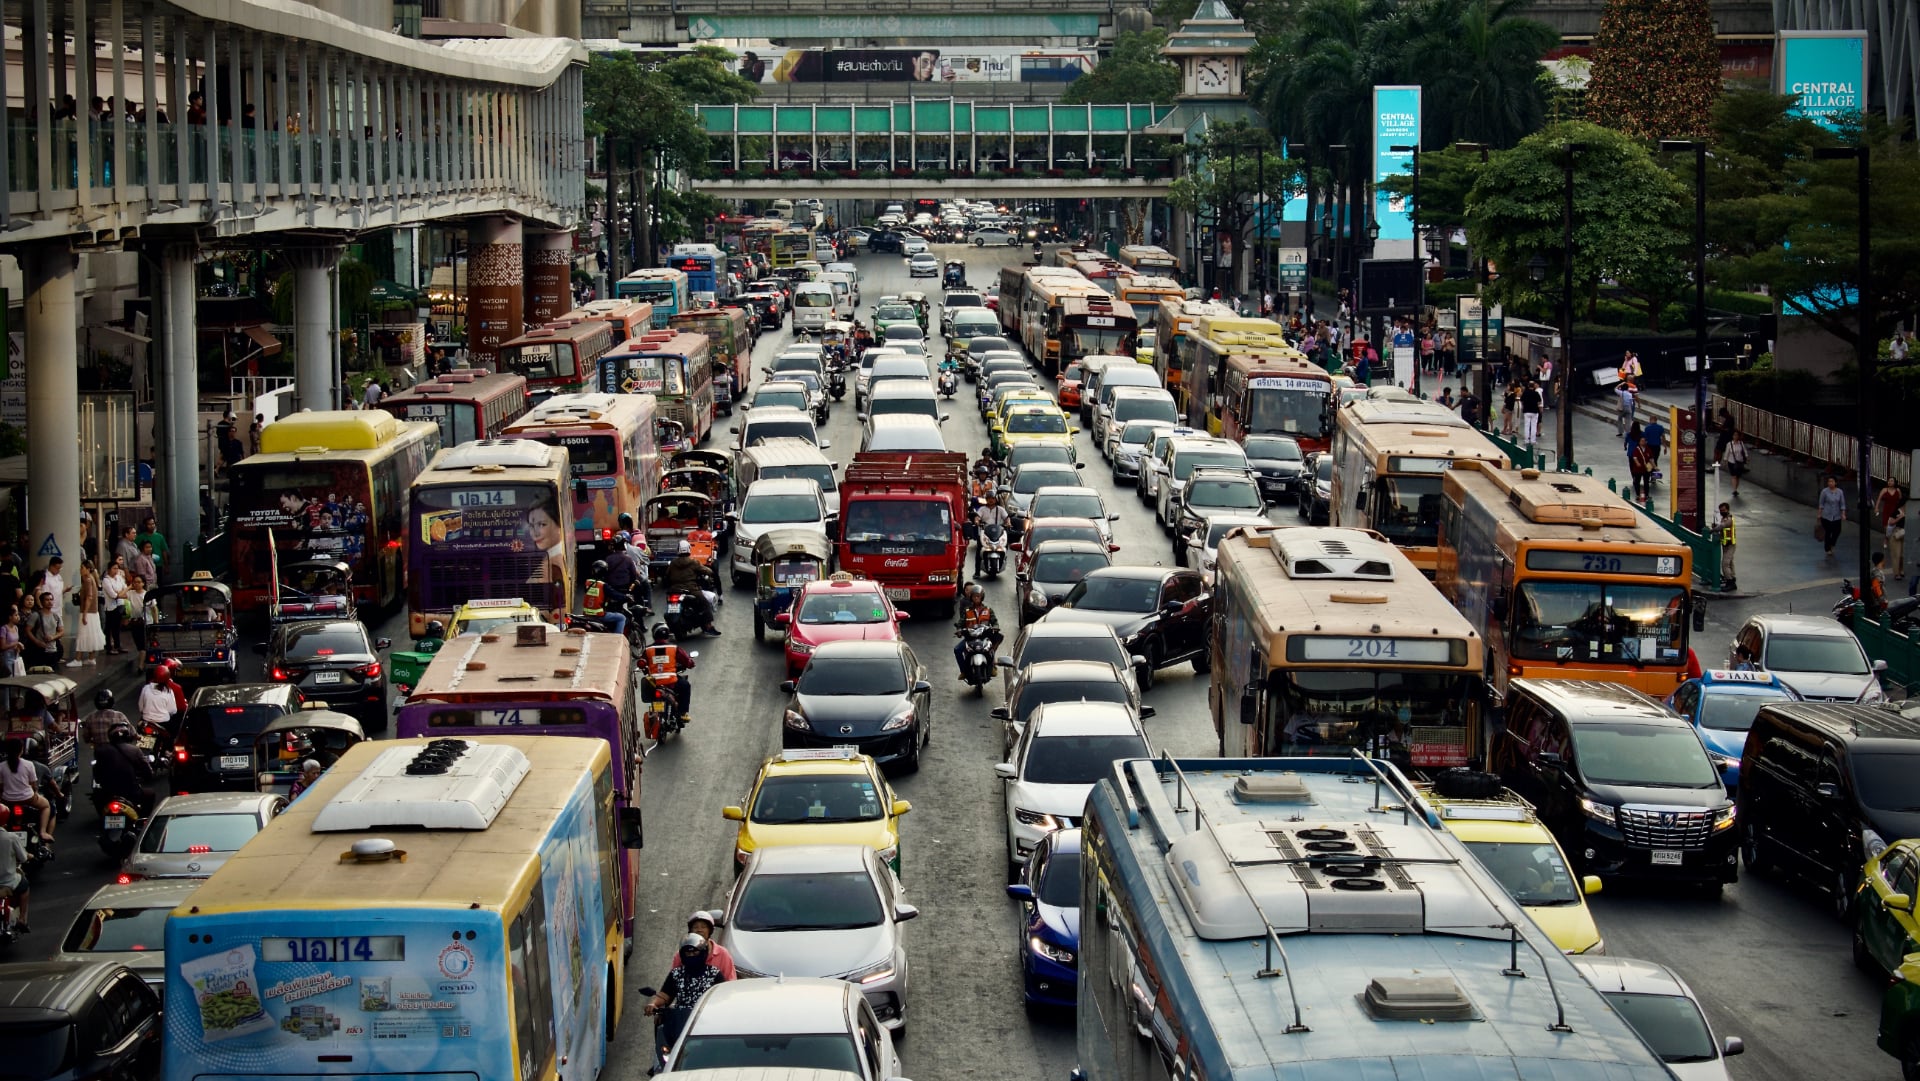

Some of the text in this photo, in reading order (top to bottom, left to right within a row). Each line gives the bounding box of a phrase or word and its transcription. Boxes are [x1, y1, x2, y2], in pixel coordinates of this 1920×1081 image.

[1792, 82, 1855, 94] CENTRAL
[632, 379, 662, 389] PUMA
[1286, 380, 1294, 388] 14
[421, 405, 433, 415] 13
[1582, 555, 1622, 571] 73ก
[1657, 566, 1673, 574] GPS
[1348, 639, 1399, 658] 204
[393, 669, 410, 677] Grab
[1728, 672, 1756, 681] TAXI
[494, 709, 523, 725] 74
